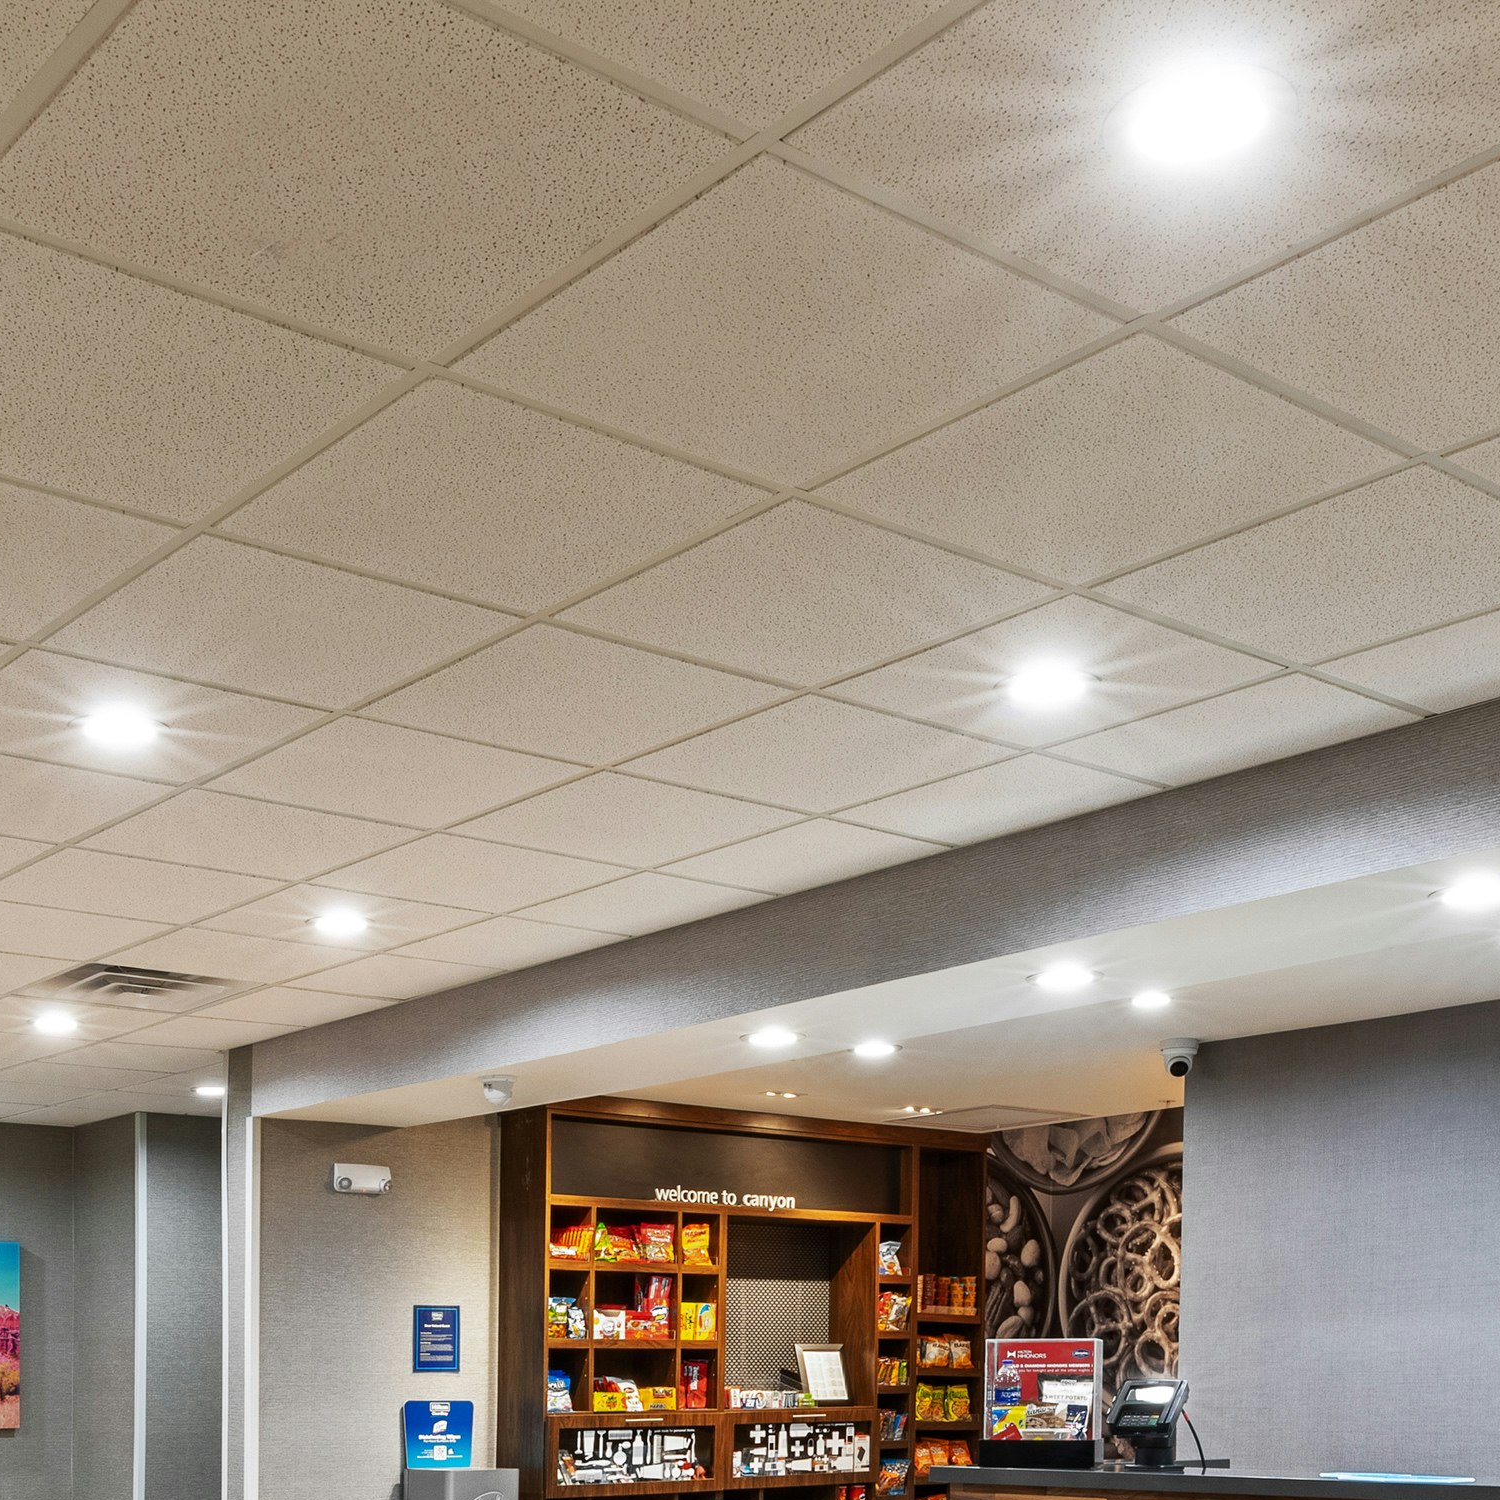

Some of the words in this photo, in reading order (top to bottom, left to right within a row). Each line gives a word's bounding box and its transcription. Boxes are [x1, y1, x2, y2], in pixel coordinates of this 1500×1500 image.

[655, 1185, 719, 1205] welcome
[722, 1190, 737, 1205] to
[743, 1193, 796, 1212] canyon
